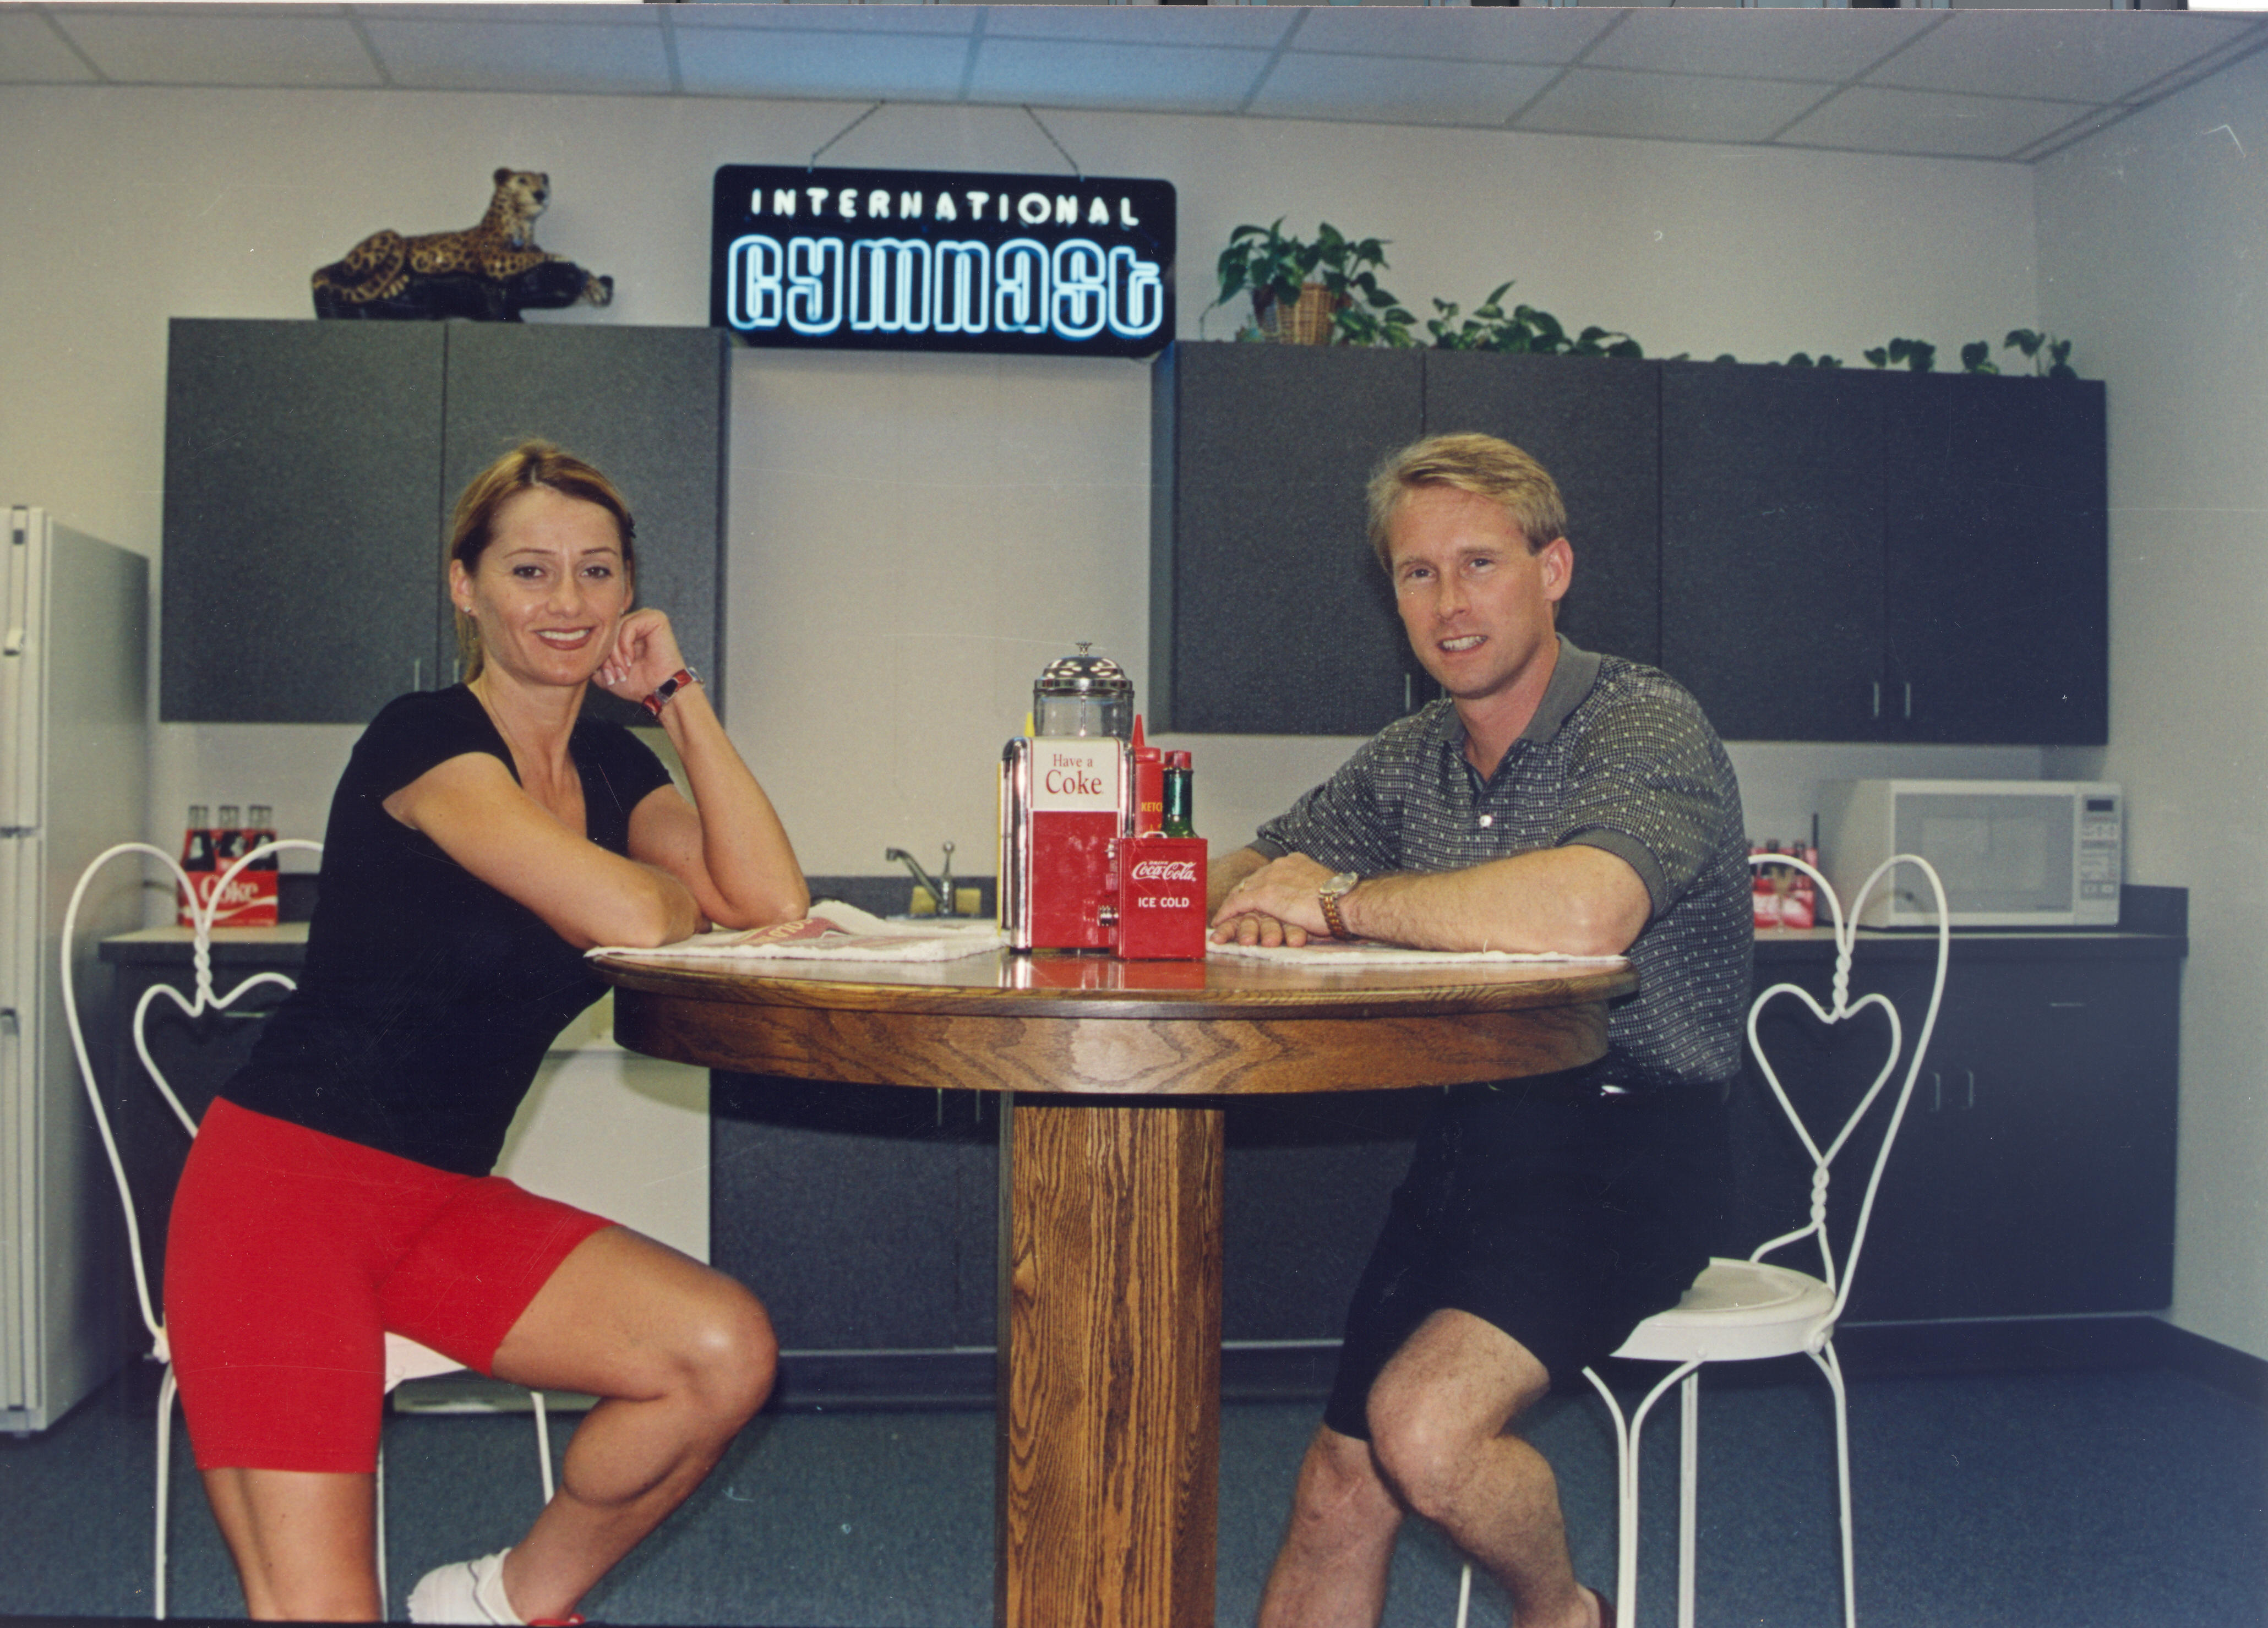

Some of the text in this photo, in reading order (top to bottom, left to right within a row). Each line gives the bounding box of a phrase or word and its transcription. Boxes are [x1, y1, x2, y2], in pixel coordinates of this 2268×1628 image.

[751, 188, 1139, 226] INTERNATIONAL
[1053, 753, 1093, 767] Have a
[1046, 769, 1102, 795] Coke
[1132, 861, 1197, 881] Coca-Cola
[1138, 897, 1190, 908] ICE COLD
